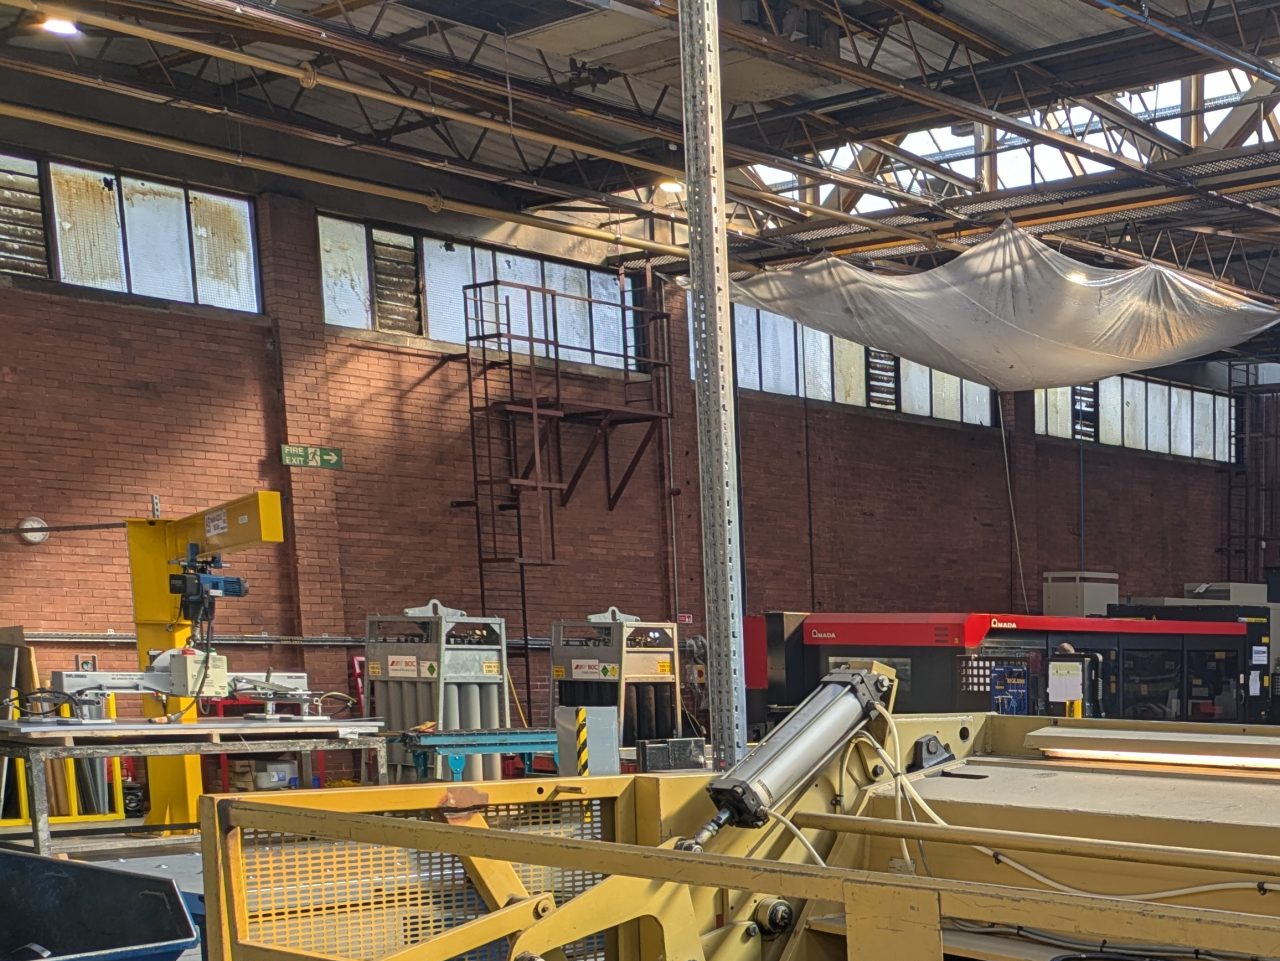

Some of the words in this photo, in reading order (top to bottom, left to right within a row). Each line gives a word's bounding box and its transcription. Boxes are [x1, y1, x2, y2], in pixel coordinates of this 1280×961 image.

[284, 446, 305, 455] FIRE
[285, 456, 305, 465] EXIT
[991, 618, 1016, 628] AMADA
[811, 629, 836, 638] AMADA
